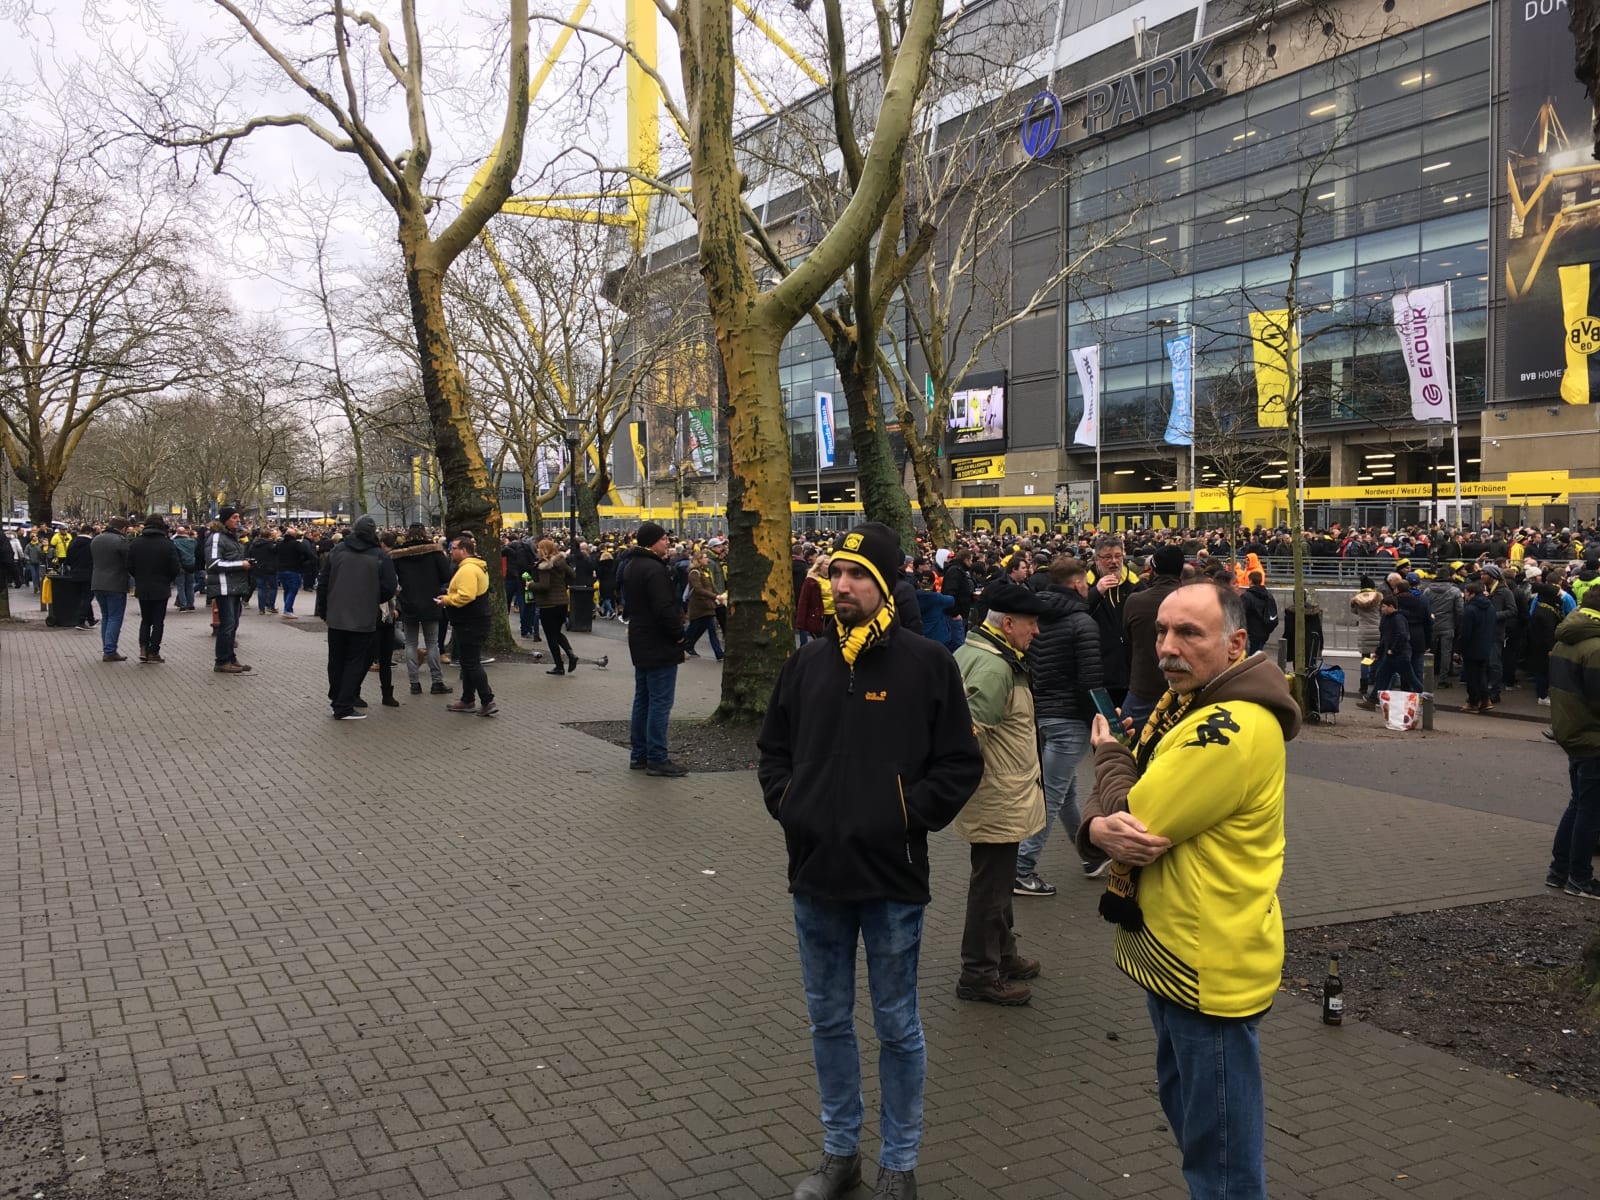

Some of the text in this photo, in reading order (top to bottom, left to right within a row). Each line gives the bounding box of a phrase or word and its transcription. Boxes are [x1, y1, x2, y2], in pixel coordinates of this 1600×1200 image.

[1087, 38, 1217, 136] PARK
[1521, 369, 1562, 381] BVB HOME
[1401, 487, 1417, 495] West
[1474, 485, 1506, 493] Tribünen
